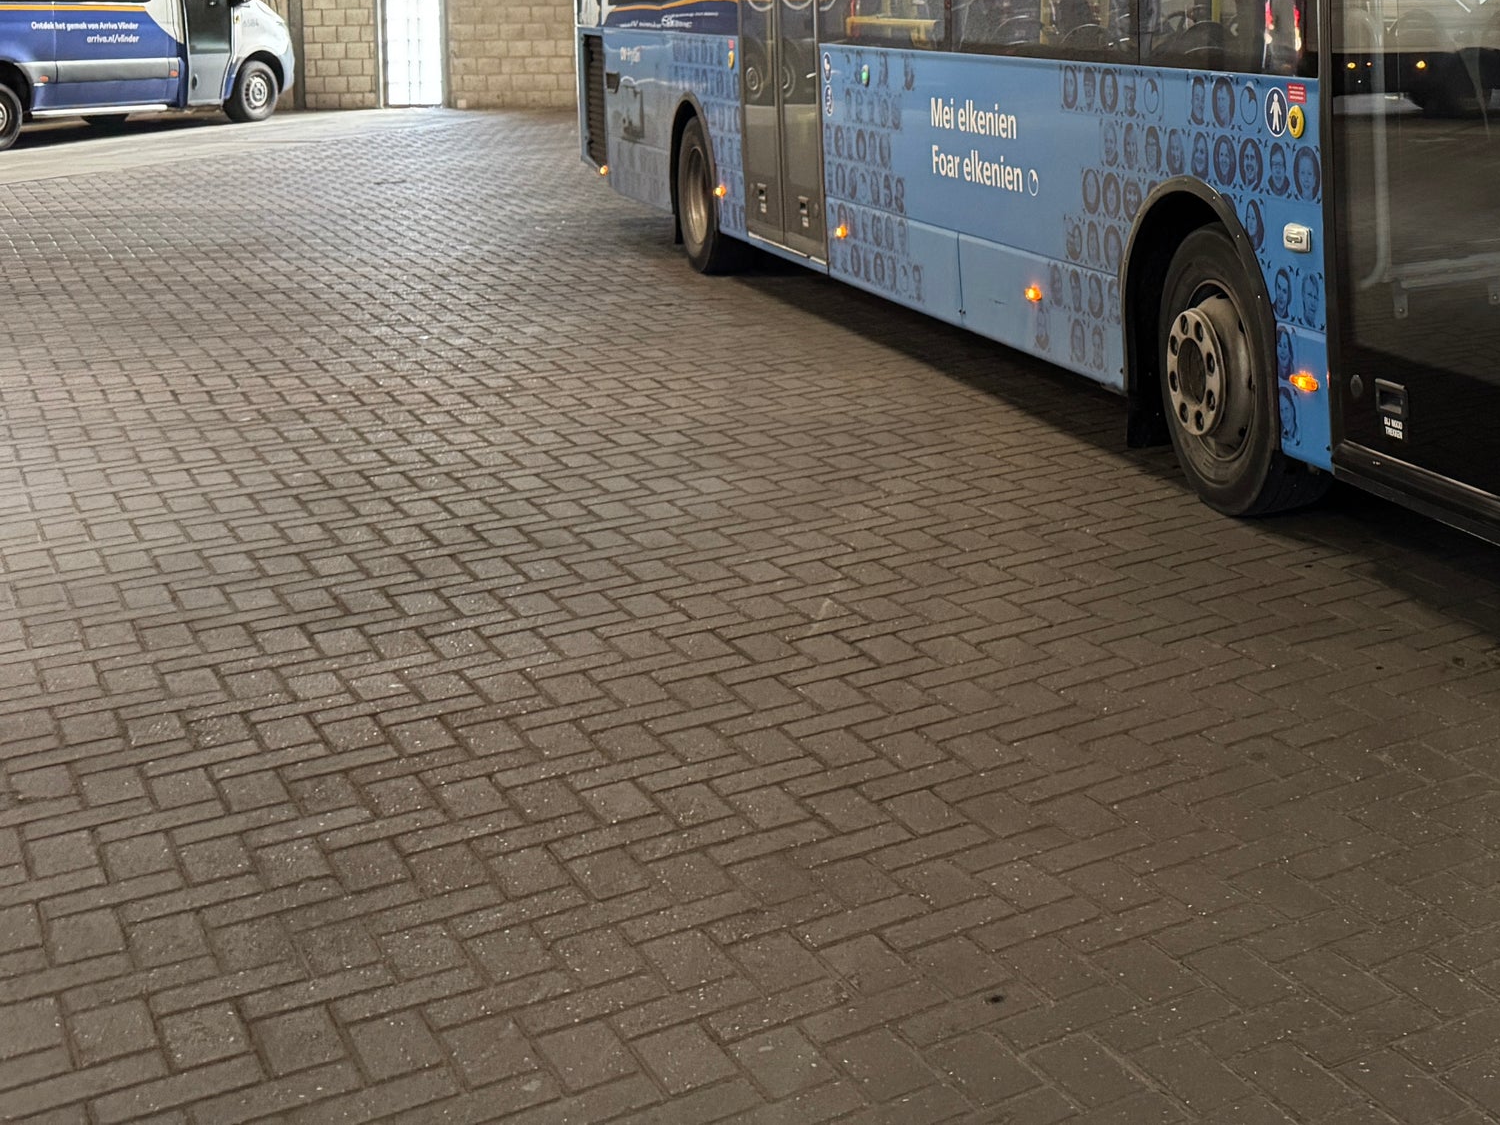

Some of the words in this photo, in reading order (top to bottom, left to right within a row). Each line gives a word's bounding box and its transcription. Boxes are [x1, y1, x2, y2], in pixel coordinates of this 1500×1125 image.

[31, 21, 54, 30] Ontdek
[54, 22, 65, 30] het
[66, 22, 87, 32] gemak
[100, 22, 118, 30] Arriva
[118, 22, 139, 30] Vlinder
[87, 34, 139, 43] arriva.nl/vlinder
[930, 97, 955, 129] Mei
[958, 99, 1017, 139] elkenien
[932, 144, 960, 178] Foar
[963, 149, 1023, 193] elkenien
